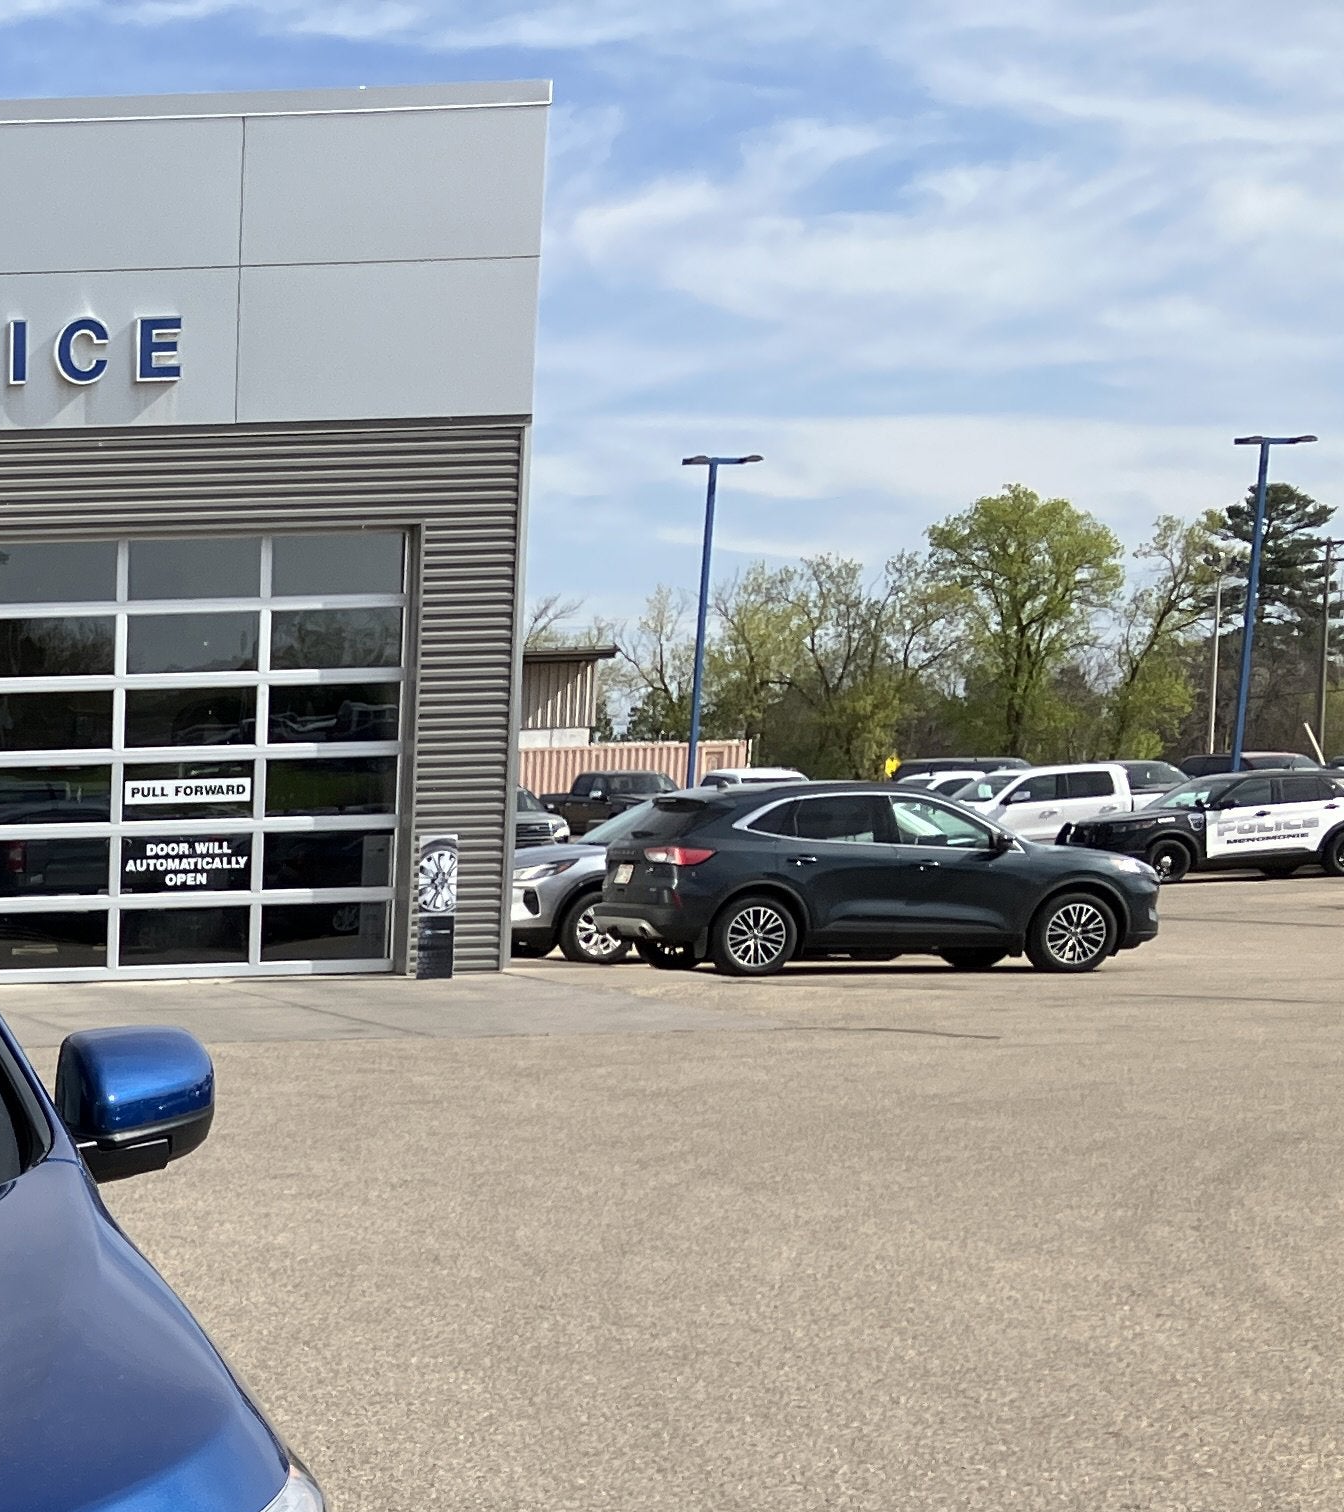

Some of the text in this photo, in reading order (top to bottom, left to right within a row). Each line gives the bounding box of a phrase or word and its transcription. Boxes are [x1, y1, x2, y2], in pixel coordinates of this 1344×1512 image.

[131, 785, 246, 798] PULL FORWARD
[1217, 817, 1320, 837] POLICE
[1226, 833, 1309, 844] MENOMONIE
[146, 842, 231, 856] DOOR WILL
[126, 857, 248, 872] AUTOMATICALLY
[165, 874, 207, 886] OPEN
